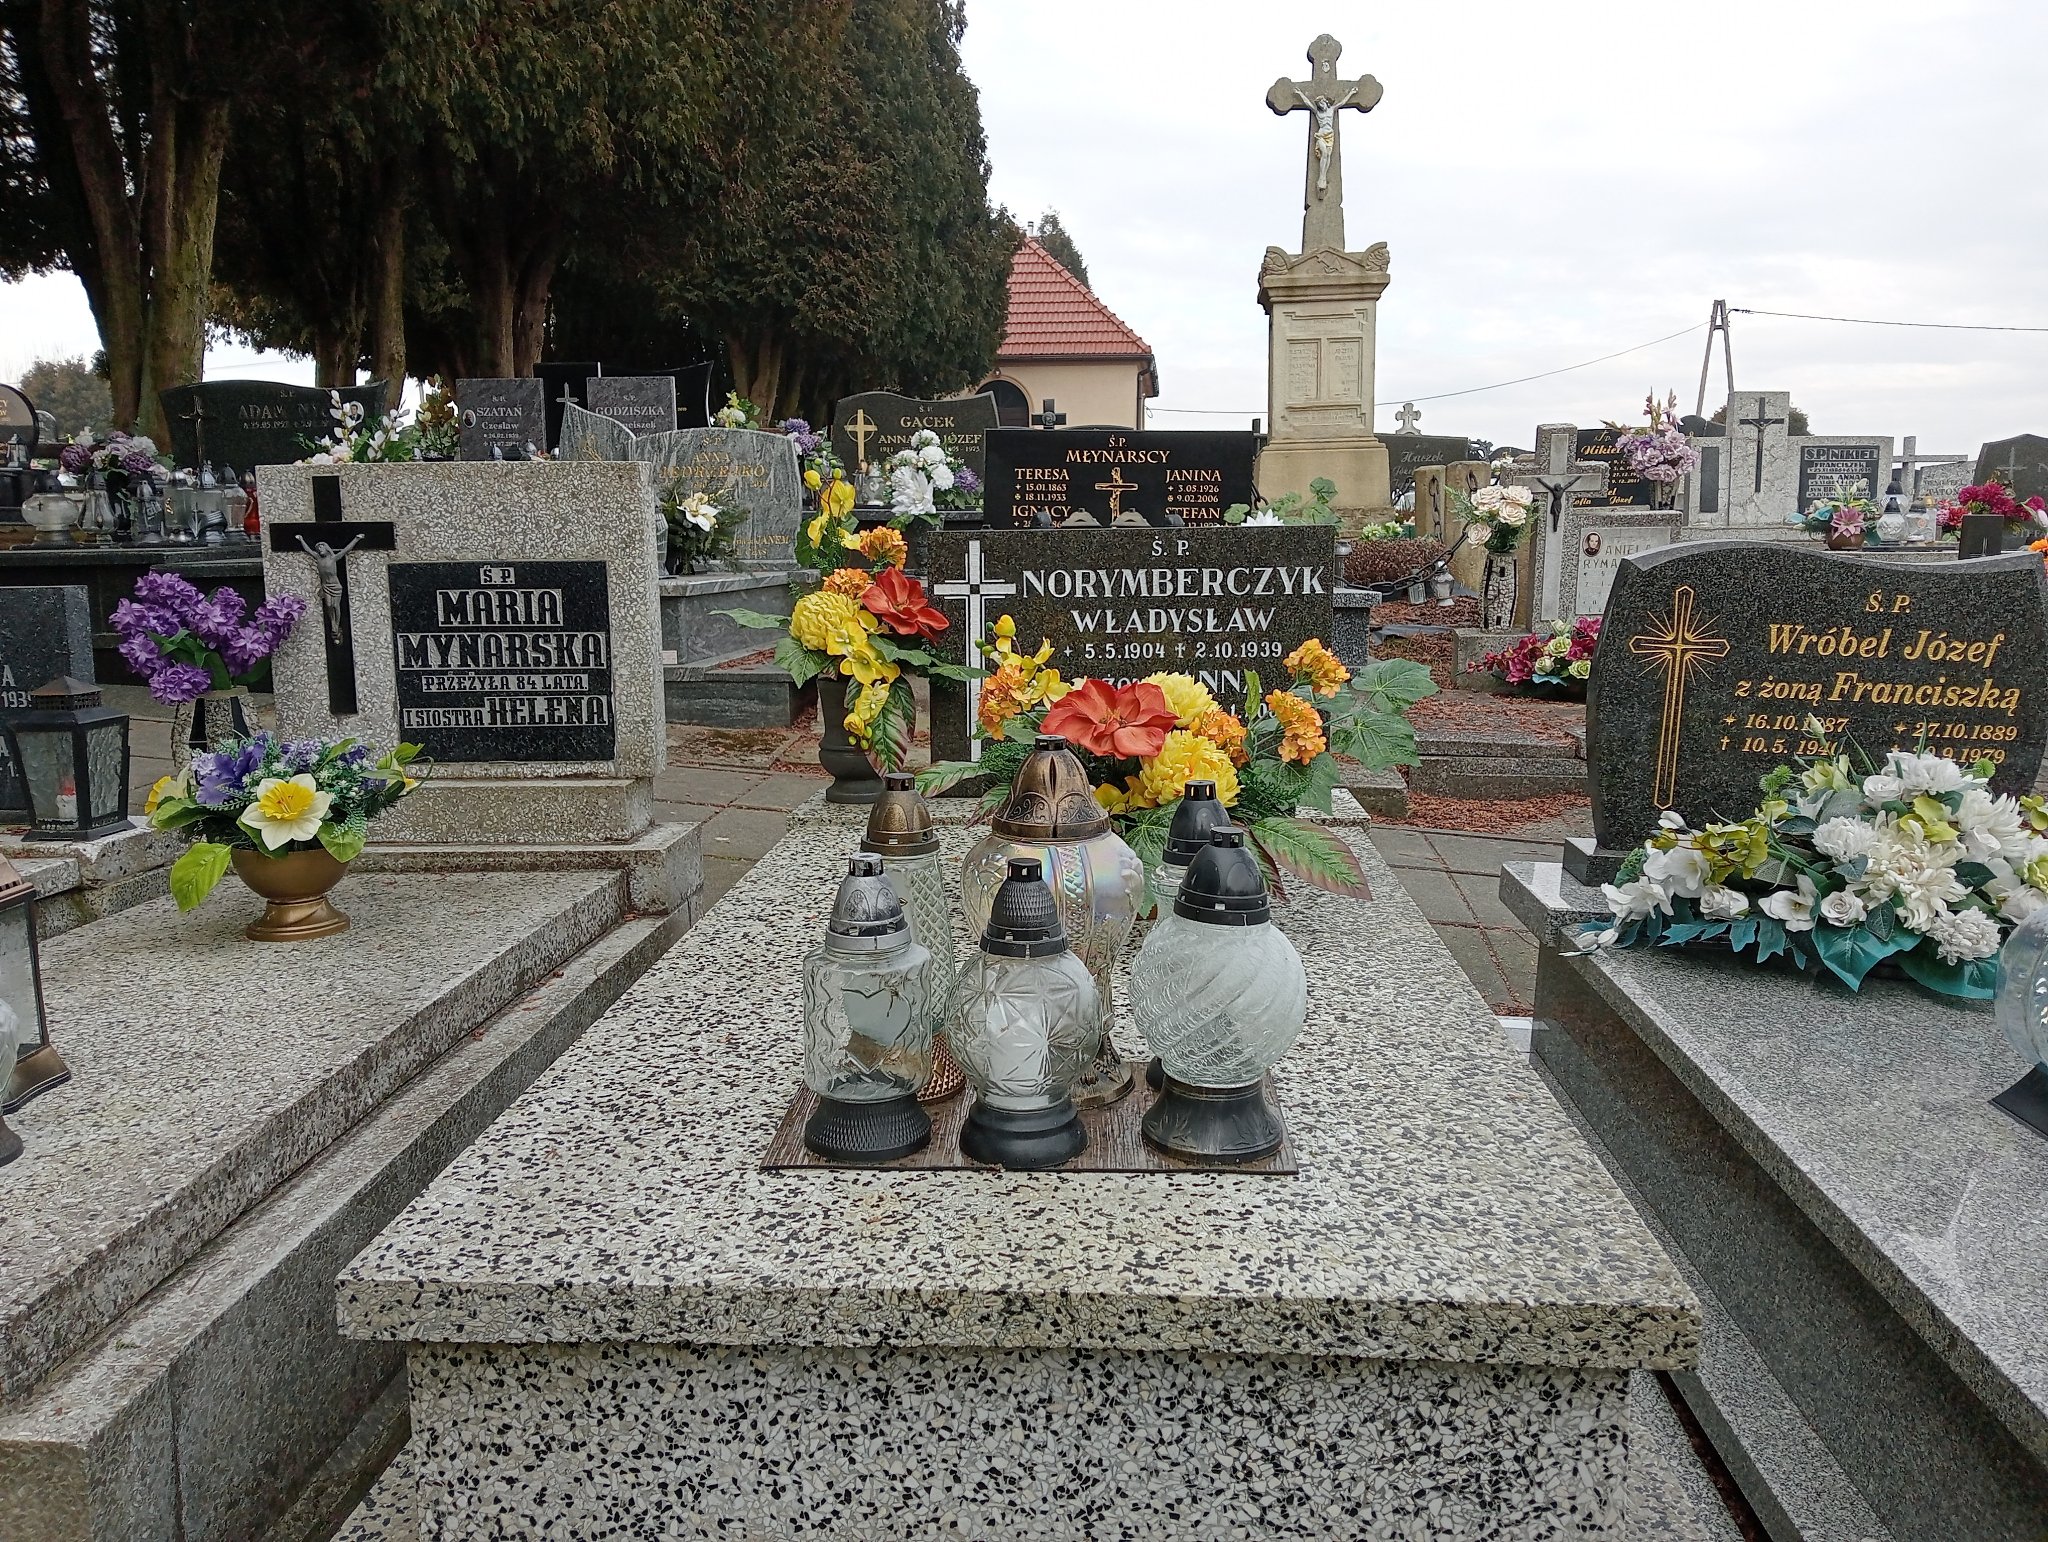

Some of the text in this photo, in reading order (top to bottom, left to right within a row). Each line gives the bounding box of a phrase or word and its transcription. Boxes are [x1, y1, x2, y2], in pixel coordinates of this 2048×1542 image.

[900, 416, 955, 428] GACEK
[1066, 449, 1170, 464] MŁYNARSCY
[1830, 448, 1878, 460] NIKIEL
[1015, 468, 1222, 483] TERESA JANINA
[1024, 492, 1219, 503] 18.11.1933 9.02.2006
[1025, 483, 1067, 492] 15.01.1863
[1151, 535, 1190, 557] Ś. P.
[1022, 565, 1325, 599] NORYMBERCZYK
[438, 589, 562, 626] MARIA
[1864, 588, 1911, 614] Ś. P.
[1070, 606, 1277, 634] WŁADYSŁAW
[398, 632, 606, 669] MYNARSKA
[1194, 641, 1283, 659] 2.10.1939
[1767, 622, 2006, 669] Wróbel Józef
[516, 675, 538, 690] 84
[541, 675, 588, 690] LATA.
[1735, 671, 2020, 717] z żoną Franciszką
[415, 708, 485, 727] SIOSTRA
[487, 695, 608, 726] HELENA
[1911, 721, 2018, 741] 27.10.1889
